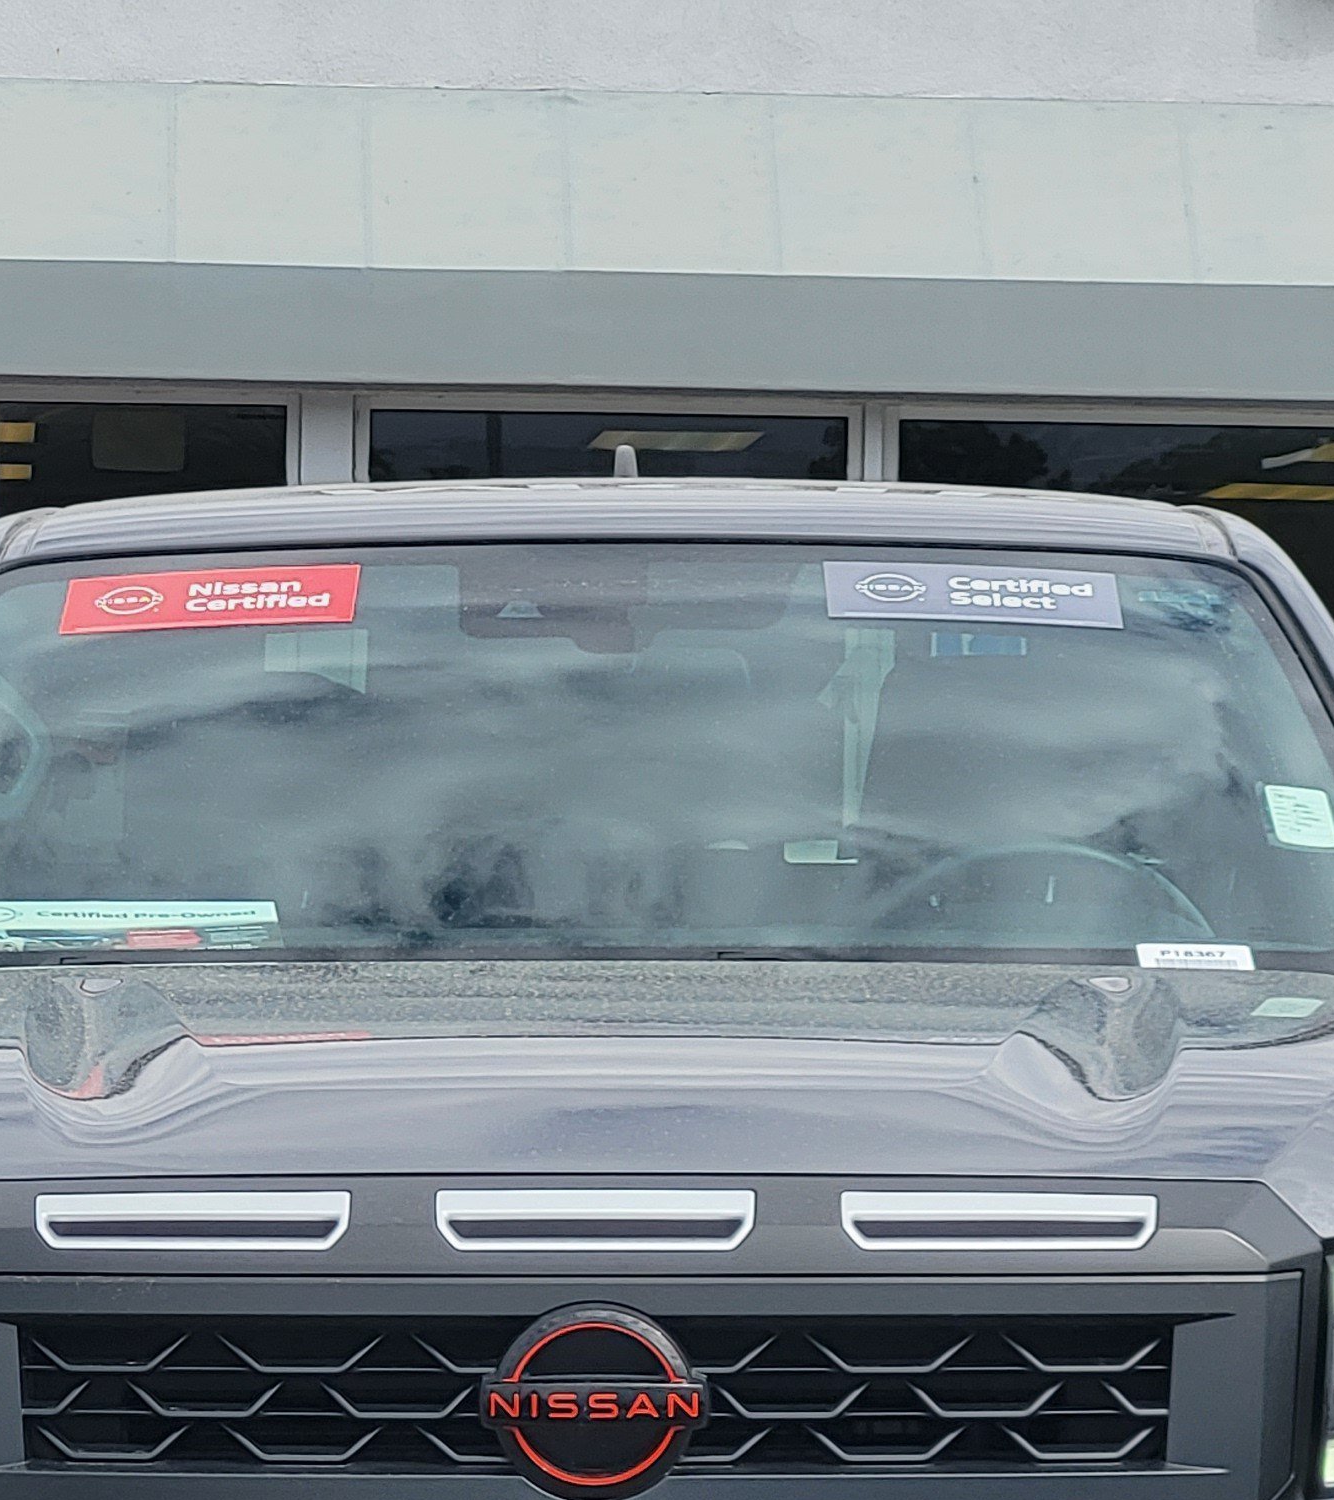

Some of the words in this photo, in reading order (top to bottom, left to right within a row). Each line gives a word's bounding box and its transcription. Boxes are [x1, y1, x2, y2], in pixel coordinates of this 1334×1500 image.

[188, 580, 302, 597] Nissan
[854, 582, 927, 593] NISSAN
[947, 576, 1094, 597] Certified
[185, 592, 331, 612] Certified
[949, 592, 1057, 610] Select
[37, 909, 128, 919] Certified
[134, 908, 257, 919] Pre-Owned
[1160, 950, 1226, 958] P18367
[488, 1392, 700, 1419] NISSAN
